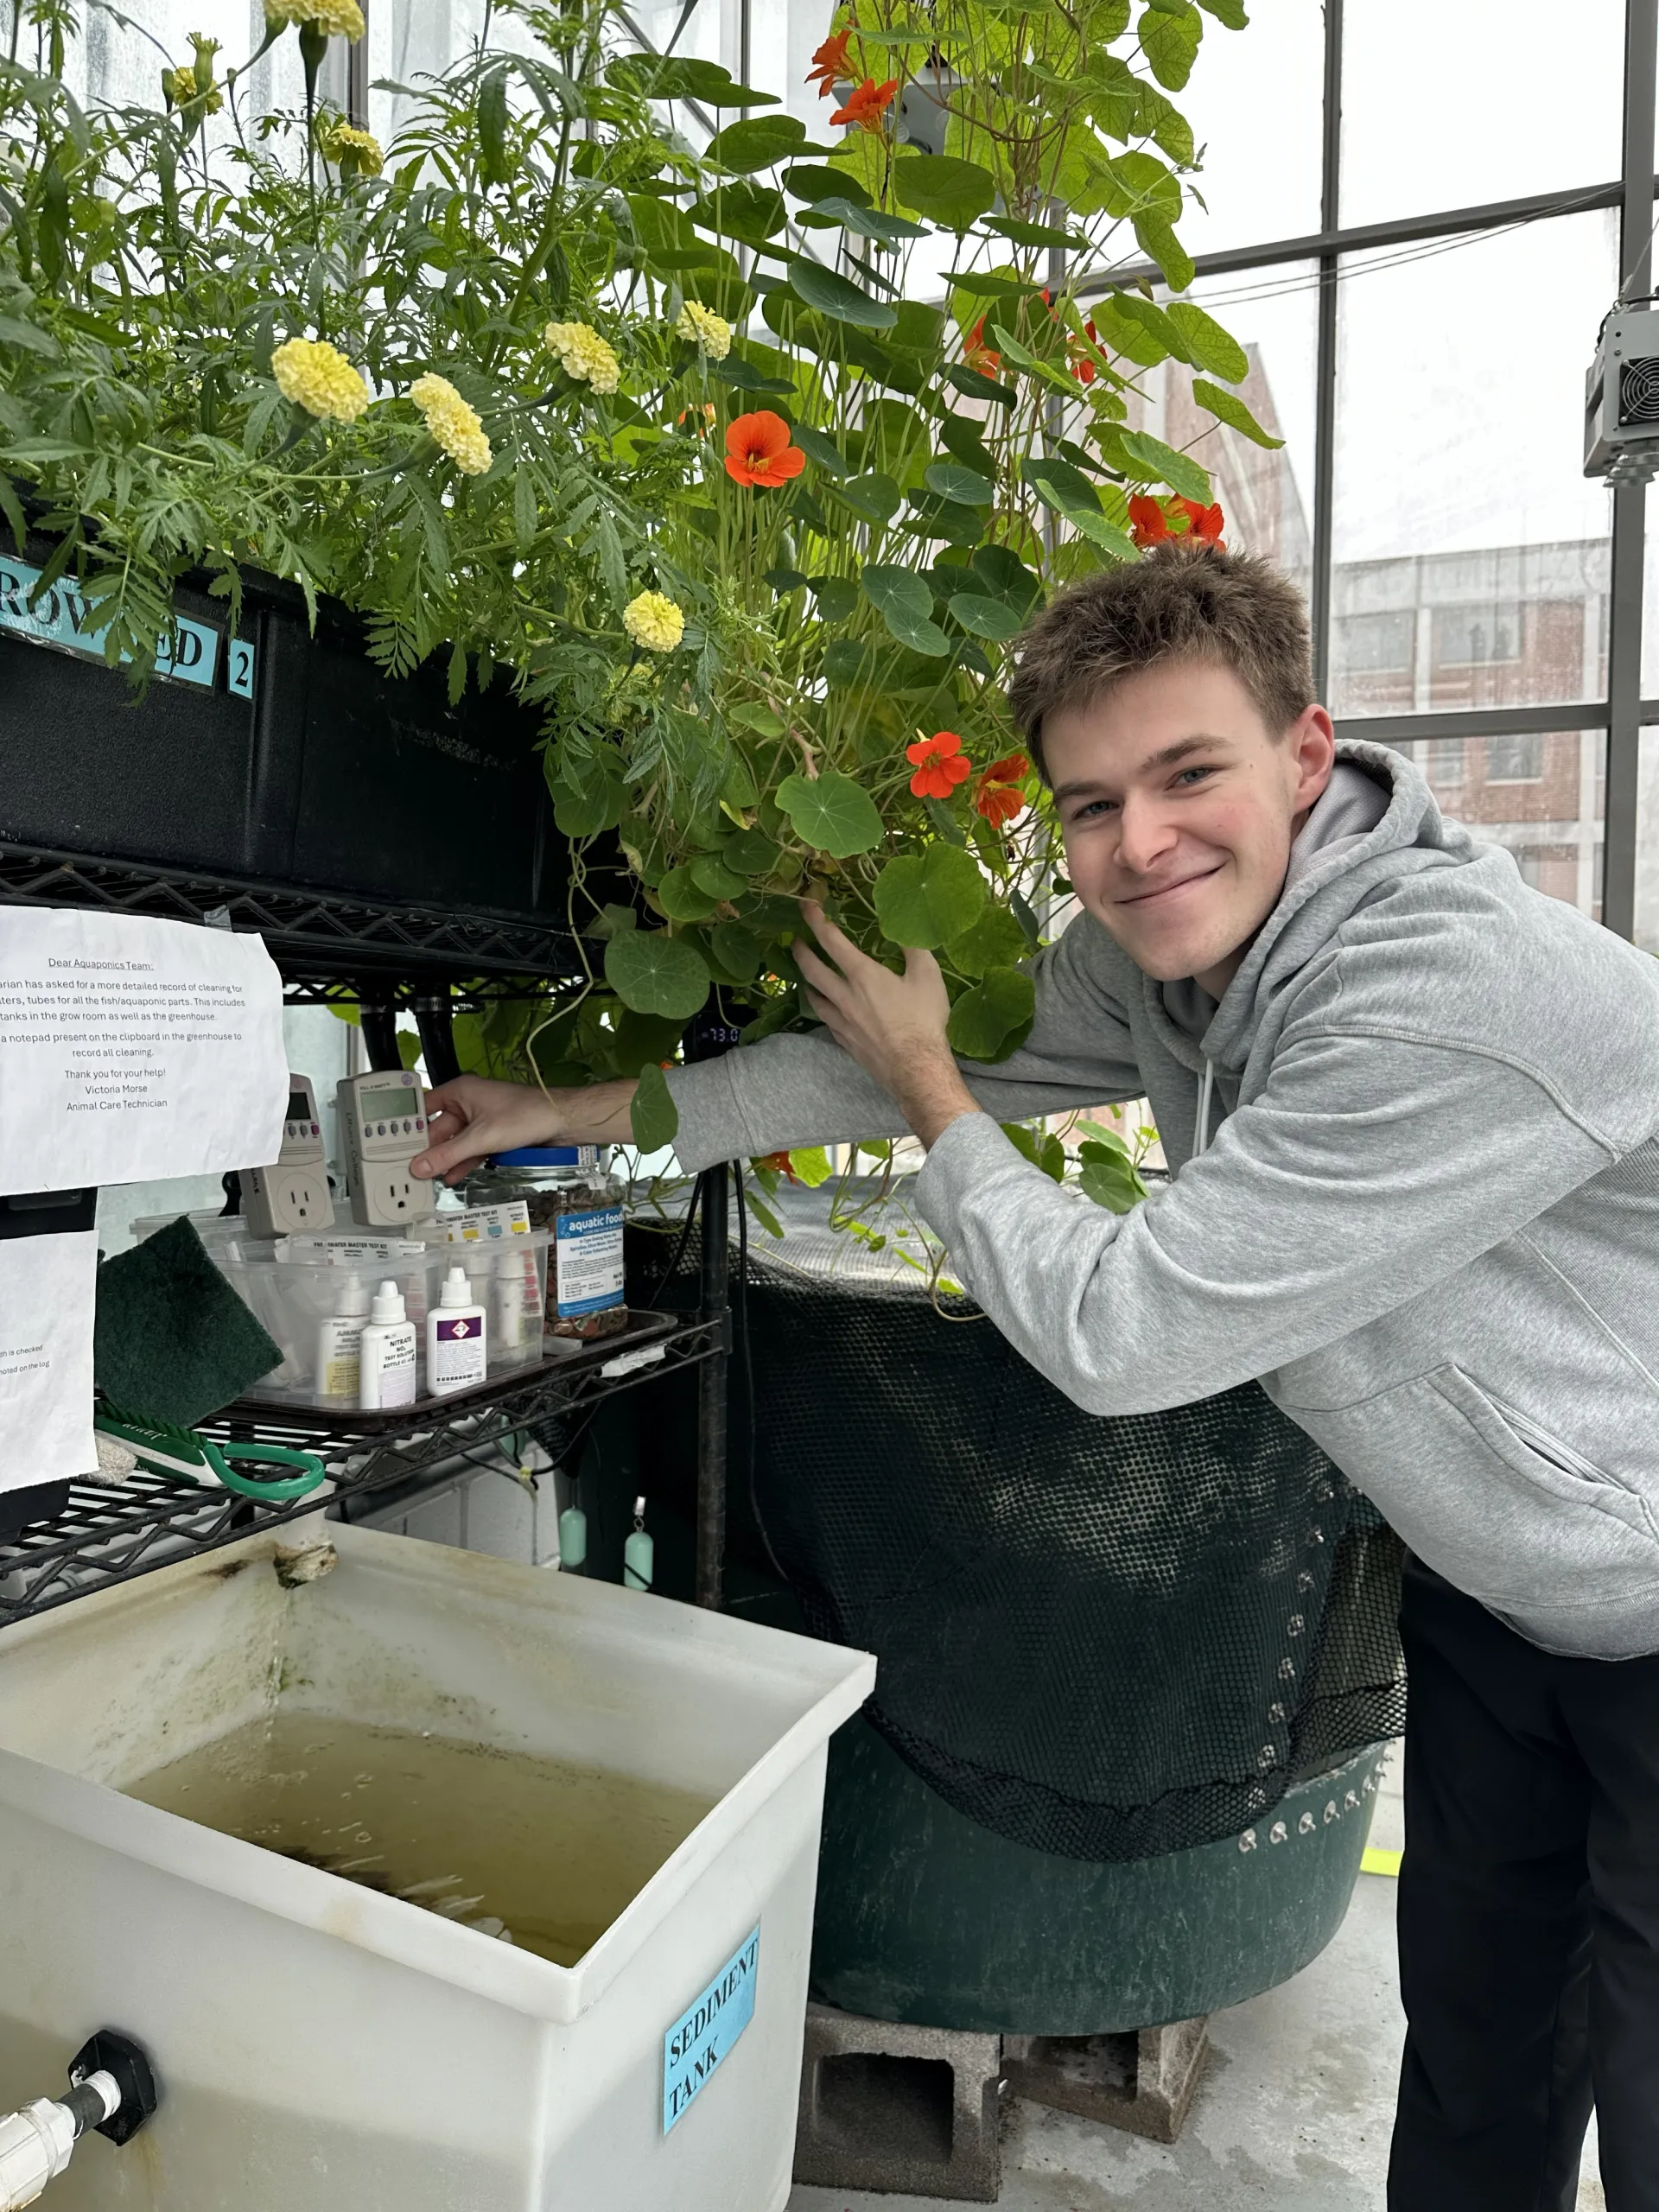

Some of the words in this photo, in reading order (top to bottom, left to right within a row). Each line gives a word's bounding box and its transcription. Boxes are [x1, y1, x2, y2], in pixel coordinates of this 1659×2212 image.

[235, 652, 249, 688] 2
[48, 958, 72, 967] Dear
[74, 959, 124, 970] Aquaponics
[126, 962, 154, 970] Team:
[25, 980, 43, 988] has
[46, 980, 74, 988] asked
[76, 981, 89, 989] for
[122, 982, 158, 991] detailed
[160, 982, 187, 991] record
[198, 983, 232, 994] cleaning
[232, 984, 242, 993] for
[28, 996, 55, 1005] tubes
[57, 996, 70, 1005] for
[73, 996, 84, 1005] all
[86, 996, 99, 1005] the
[101, 996, 167, 1007] fish/aquaponic
[168, 998, 193, 1007] parts.
[0, 1012, 28, 1021] tanks
[29, 1012, 39, 1020] in
[41, 1012, 57, 1020] the
[60, 1014, 80, 1022] grow
[121, 1012, 139, 1020] well
[168, 1013, 218, 1022] greenhouse.
[10, 1033, 50, 1044] notepad
[53, 1034, 87, 1044] present
[102, 1033, 118, 1041] the
[119, 1033, 161, 1043] clipboard
[187, 1033, 232, 1042] greenhouse
[710, 1028, 739, 1042] 73.0
[73, 1048, 101, 1057] record
[103, 1048, 114, 1057] all
[115, 1048, 154, 1058] cleaning.
[65, 1070, 92, 1079] Thank
[92, 1071, 109, 1080] you
[111, 1069, 122, 1077] for
[124, 1070, 143, 1079] your
[144, 1068, 166, 1077] help!
[85, 1085, 121, 1095] Victoria
[123, 1084, 148, 1093] Morse
[67, 1102, 98, 1111] Animal
[99, 1101, 121, 1110] Care
[123, 1099, 168, 1109] Technician
[569, 1215, 605, 1233] aquatic
[390, 1335, 412, 1347] NITRATE
[16, 1344, 43, 1356] checked
[39, 1360, 49, 1369] log
[670, 1937, 759, 2069] SEDIMENT
[669, 2034, 719, 2120] TANK
